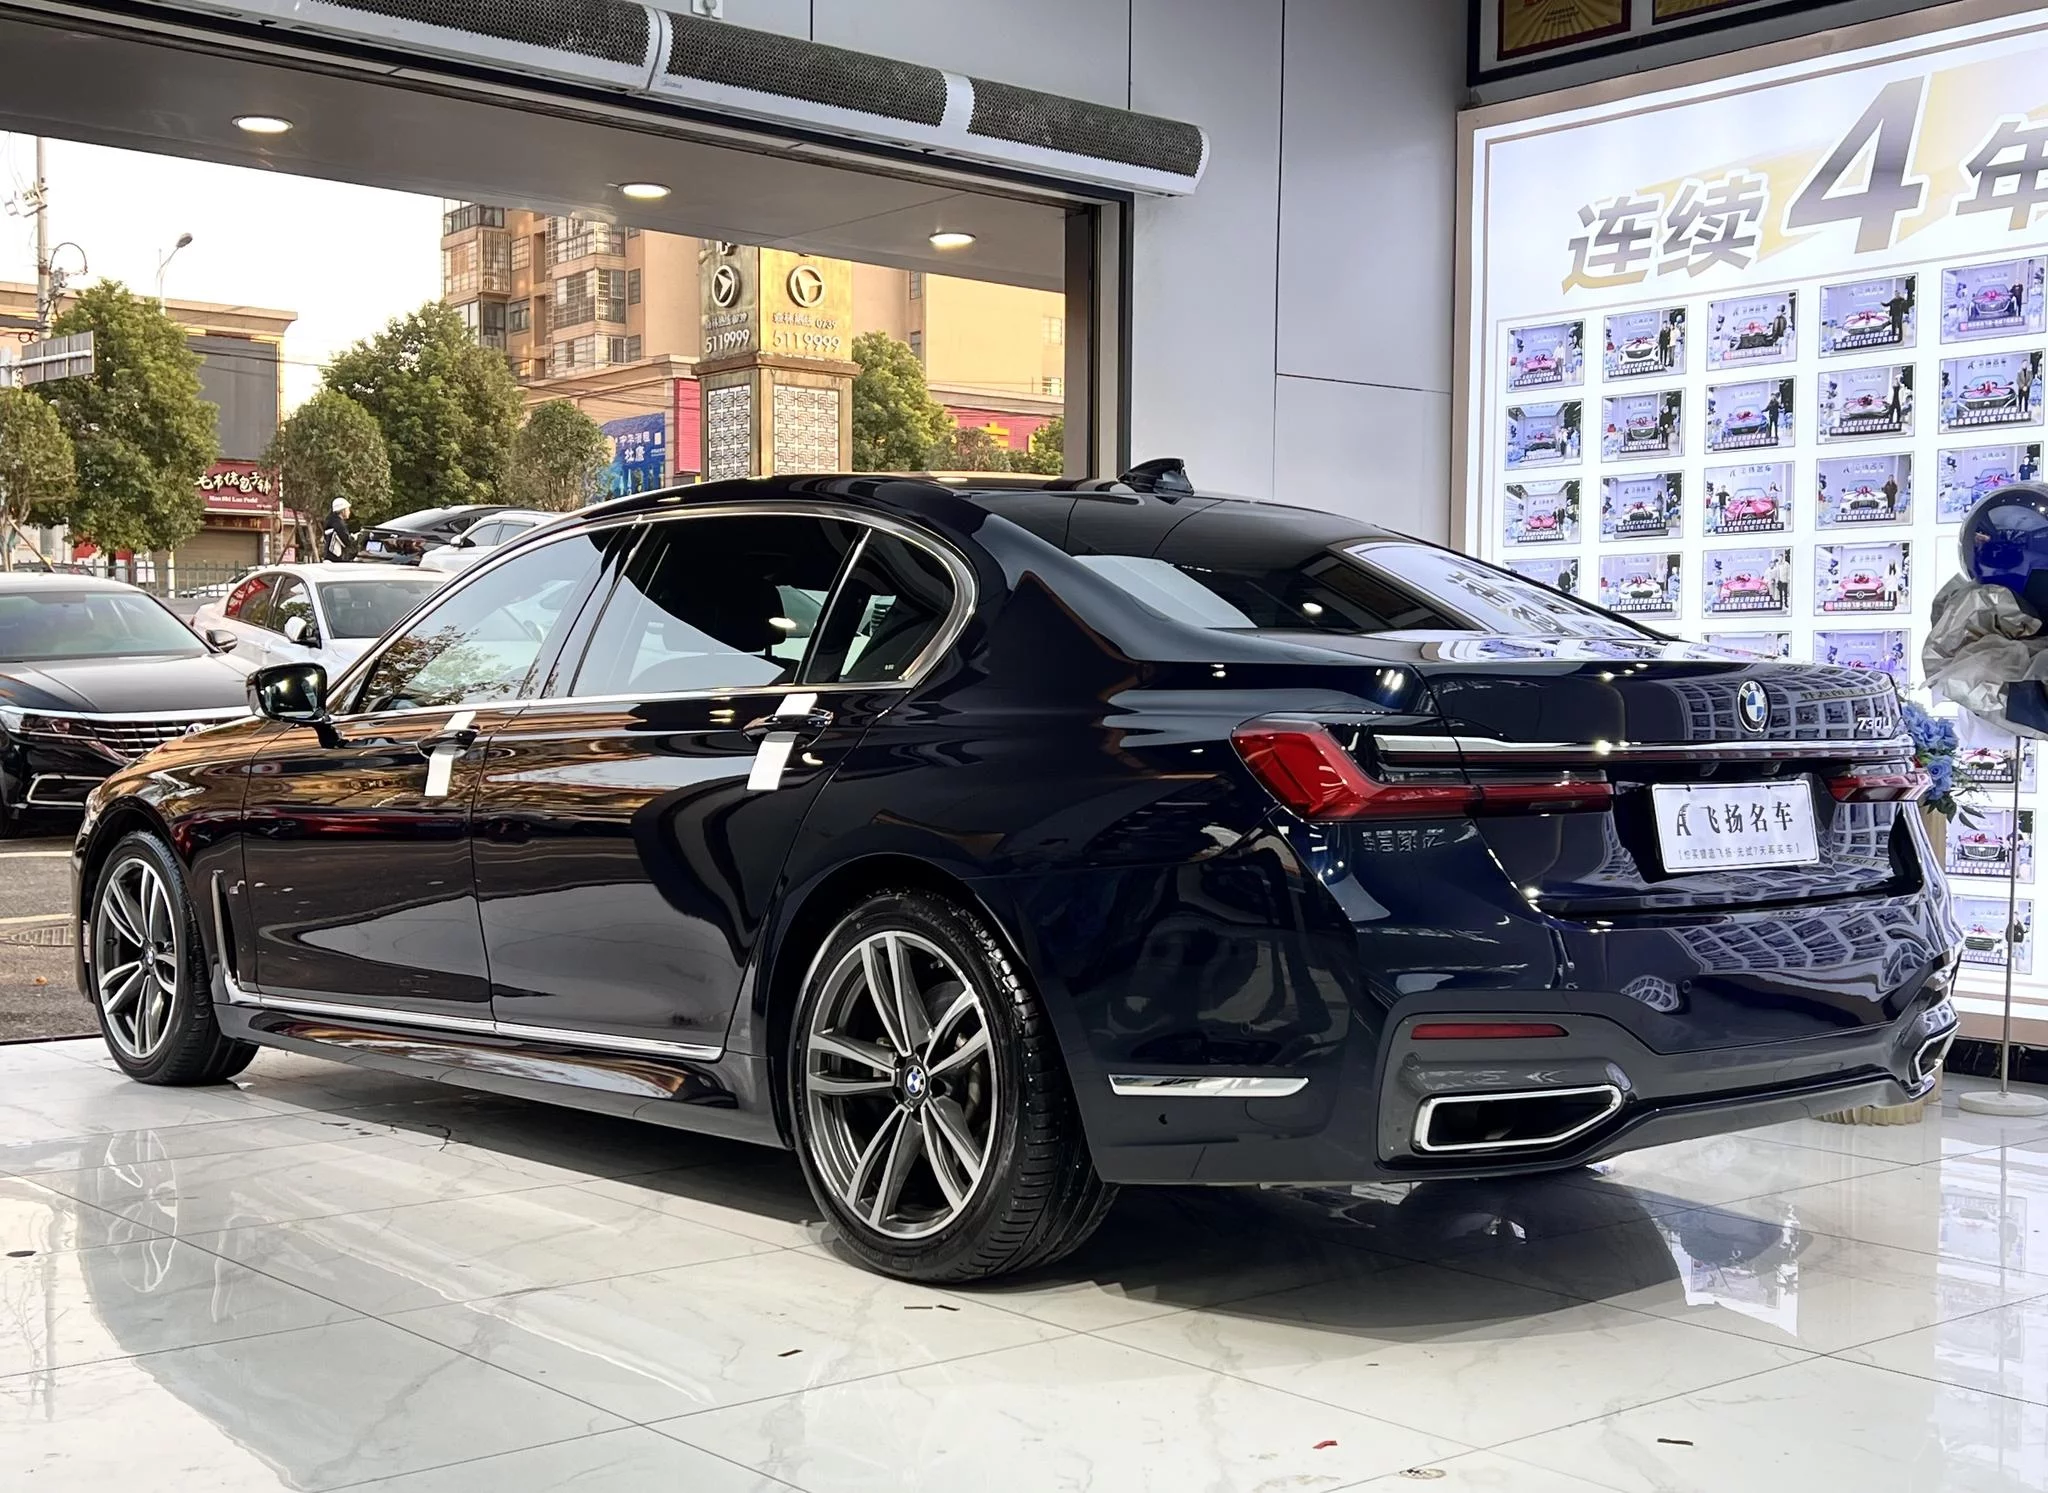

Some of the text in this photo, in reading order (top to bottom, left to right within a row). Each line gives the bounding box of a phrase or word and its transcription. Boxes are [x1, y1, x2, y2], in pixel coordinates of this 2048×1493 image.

[705, 328, 750, 354] 5119999
[772, 329, 841, 354] 5119999
[1700, 801, 1793, 834] 飞扬名车
